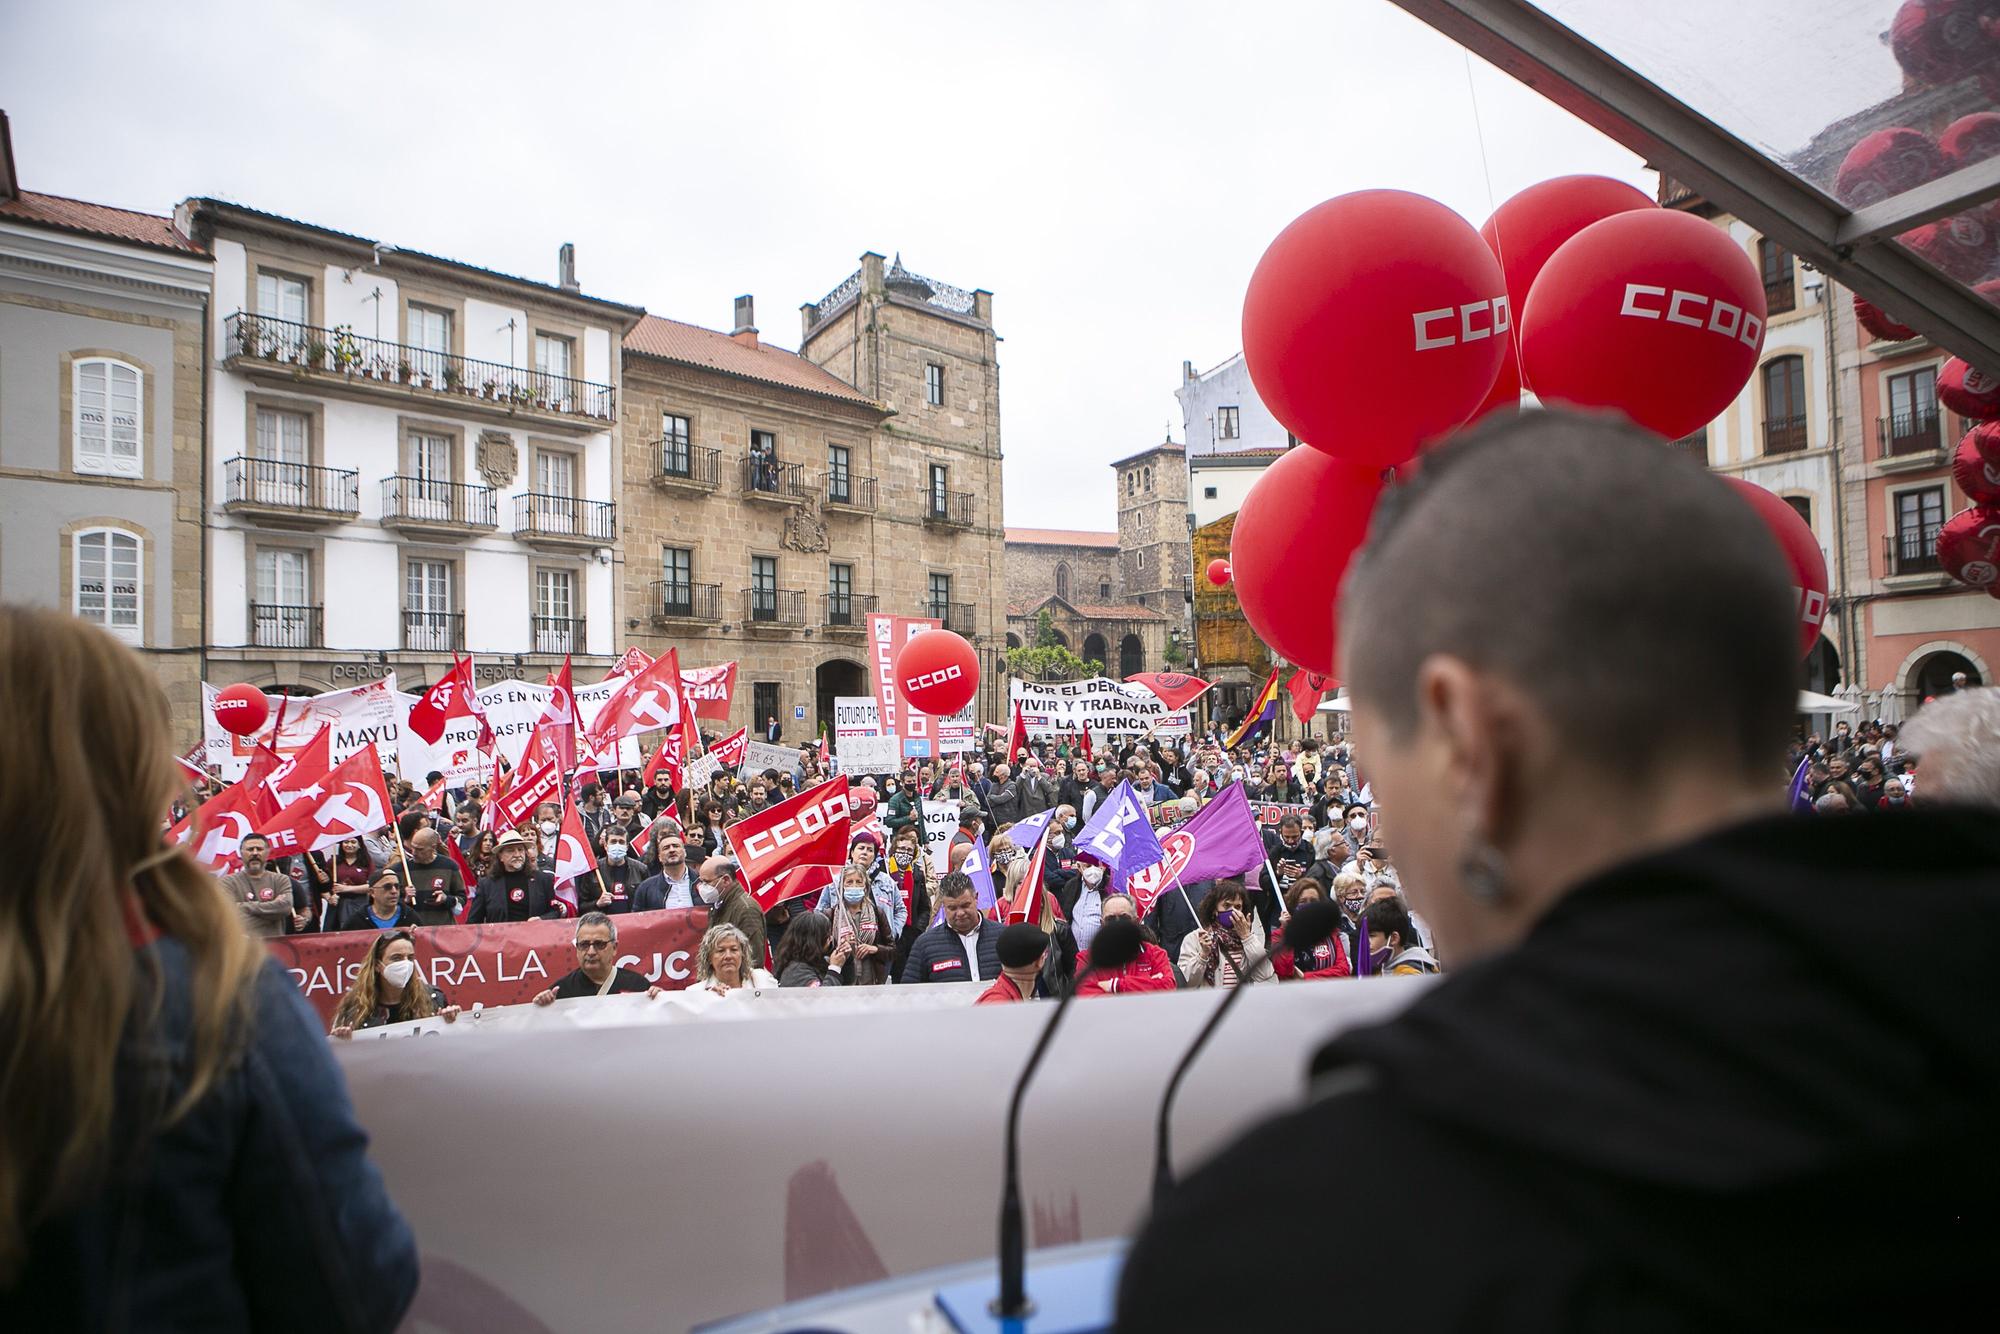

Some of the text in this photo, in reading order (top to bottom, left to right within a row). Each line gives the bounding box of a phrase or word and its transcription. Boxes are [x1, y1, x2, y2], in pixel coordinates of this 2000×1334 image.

[1413, 295, 1509, 351] CCO
[1621, 283, 1763, 349] CCOO
[332, 661, 394, 681] pepito
[906, 664, 962, 692] CCOO
[681, 682, 728, 701] TRIA
[877, 643, 896, 725] CCOO
[1022, 682, 1056, 695] POR
[1061, 685, 1082, 696] EL
[215, 699, 247, 711] CCOO
[508, 691, 527, 703] EN
[1013, 698, 1058, 712] VIVIR
[1064, 700, 1075, 712] Y
[1080, 699, 1162, 715] TRABAYAR
[837, 706, 866, 724] FUTURO
[1056, 718, 1077, 730] LA
[1083, 717, 1149, 731] CUENCA
[445, 724, 515, 744] PROAS
[595, 724, 617, 750] PCTE
[508, 769, 559, 818] CCOO
[743, 793, 851, 860] CCOO
[922, 812, 956, 824] NCIA
[266, 828, 298, 849] TE
[927, 831, 946, 842] OS
[414, 954, 486, 987] ARA
[497, 949, 548, 983] LA
